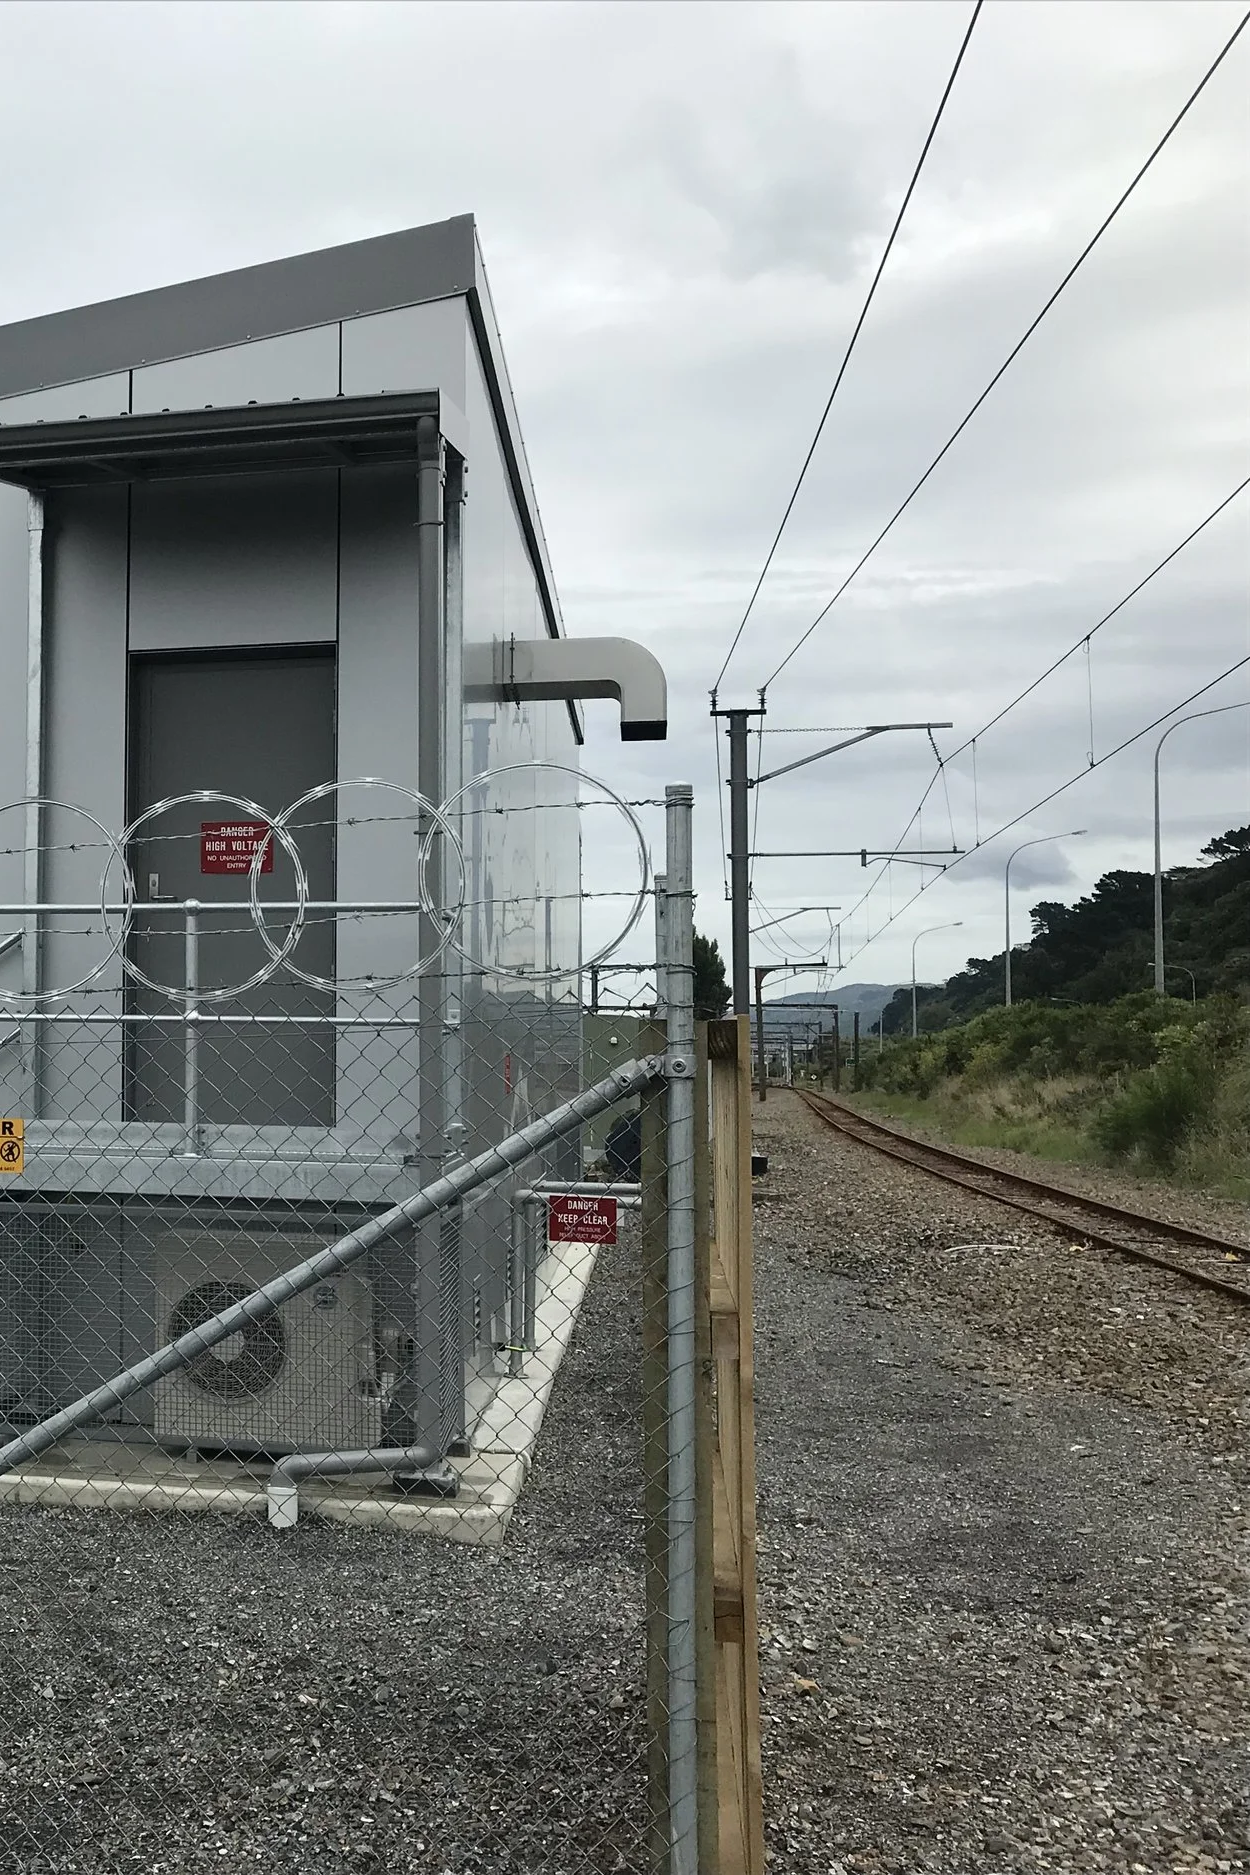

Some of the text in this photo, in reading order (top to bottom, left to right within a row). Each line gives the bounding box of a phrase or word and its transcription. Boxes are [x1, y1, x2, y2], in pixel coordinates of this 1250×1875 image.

[220, 826, 254, 837] DANGER
[205, 841, 226, 851] HIGH
[567, 1200, 599, 1211] DANGER
[558, 1213, 608, 1225] KEEP CLEAR
